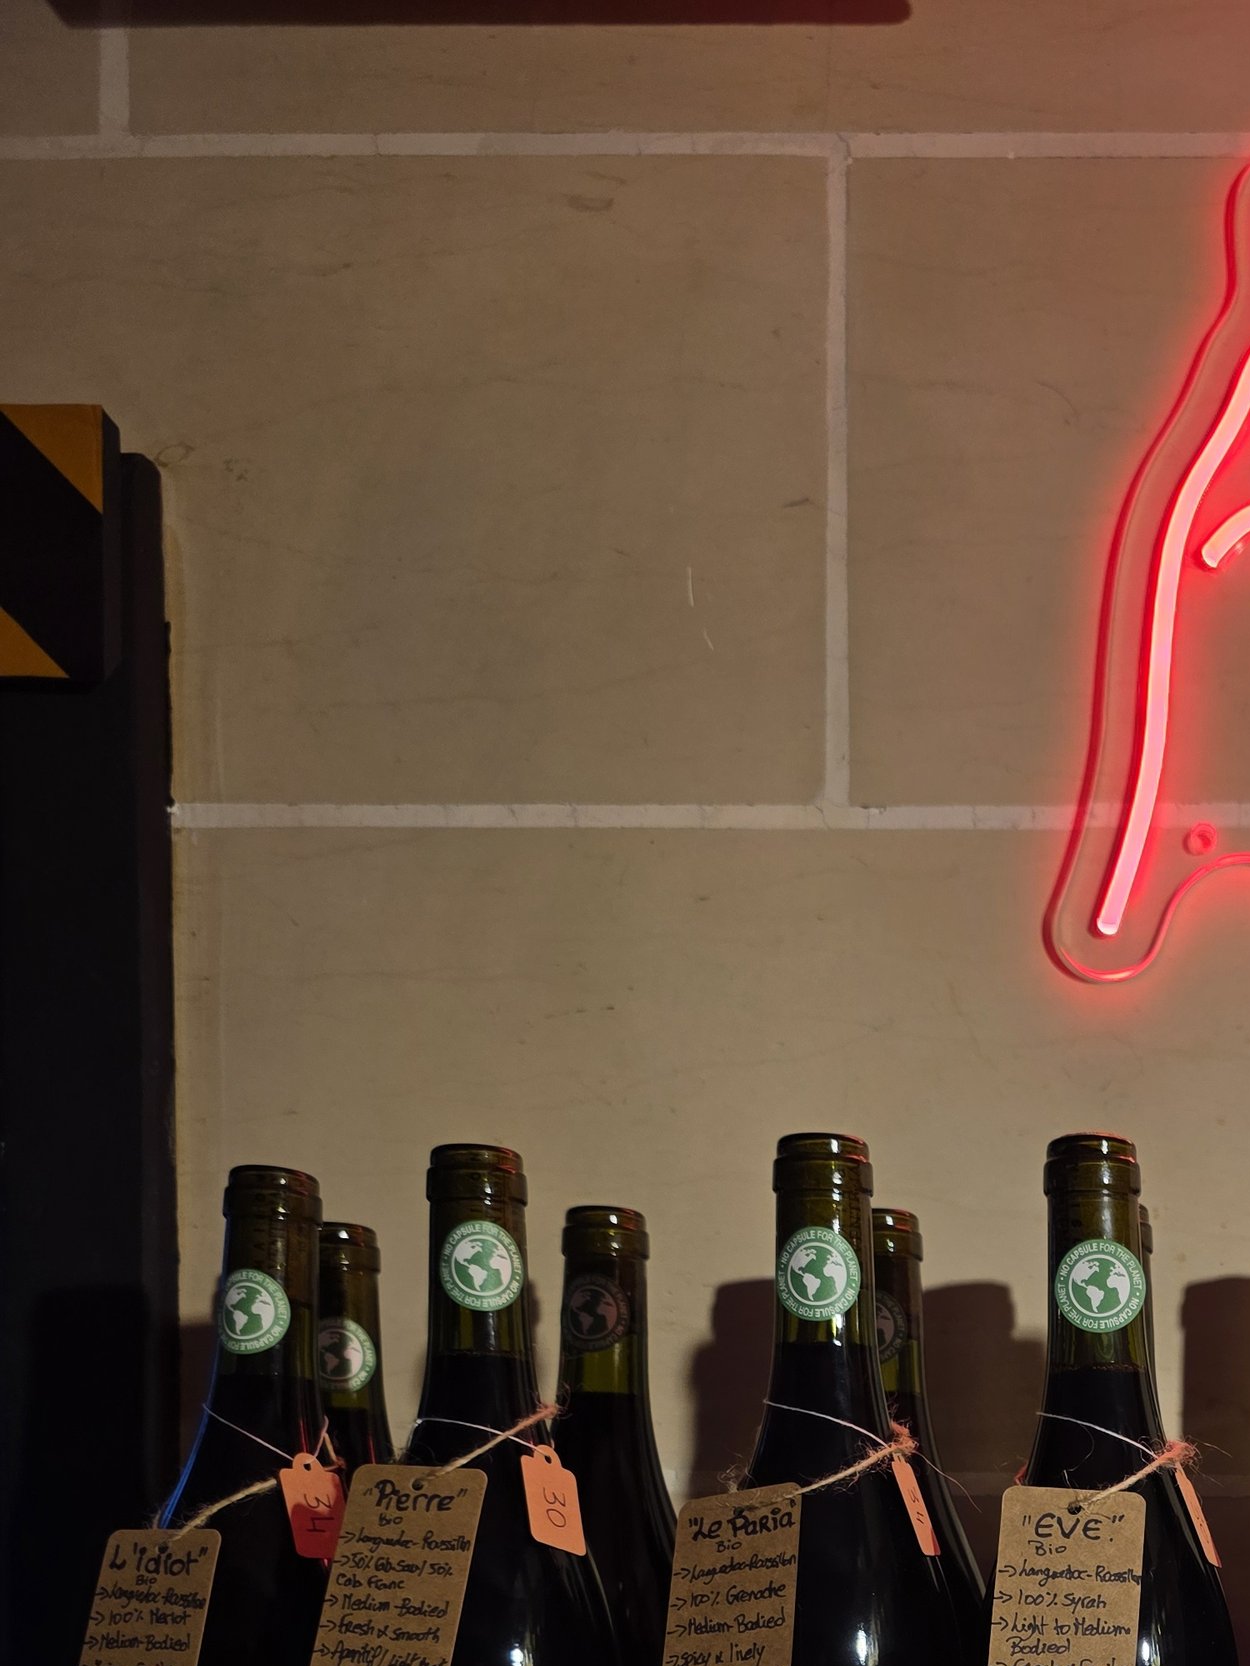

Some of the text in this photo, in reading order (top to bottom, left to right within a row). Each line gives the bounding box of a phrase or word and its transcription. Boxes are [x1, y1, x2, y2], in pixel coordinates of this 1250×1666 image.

[1060, 1242, 1142, 1289] NO CAPSULE FOR THE PLANET
[1057, 1284, 1140, 1328] NO CAPSULE FOR THE PLANET
[541, 1487, 566, 1529] 30
[716, 1540, 741, 1552] Bio
[1028, 1540, 1067, 1555] Bio
[1018, 1590, 1106, 1613] 100% Syrah
[1006, 1637, 1070, 1656] Bodied
